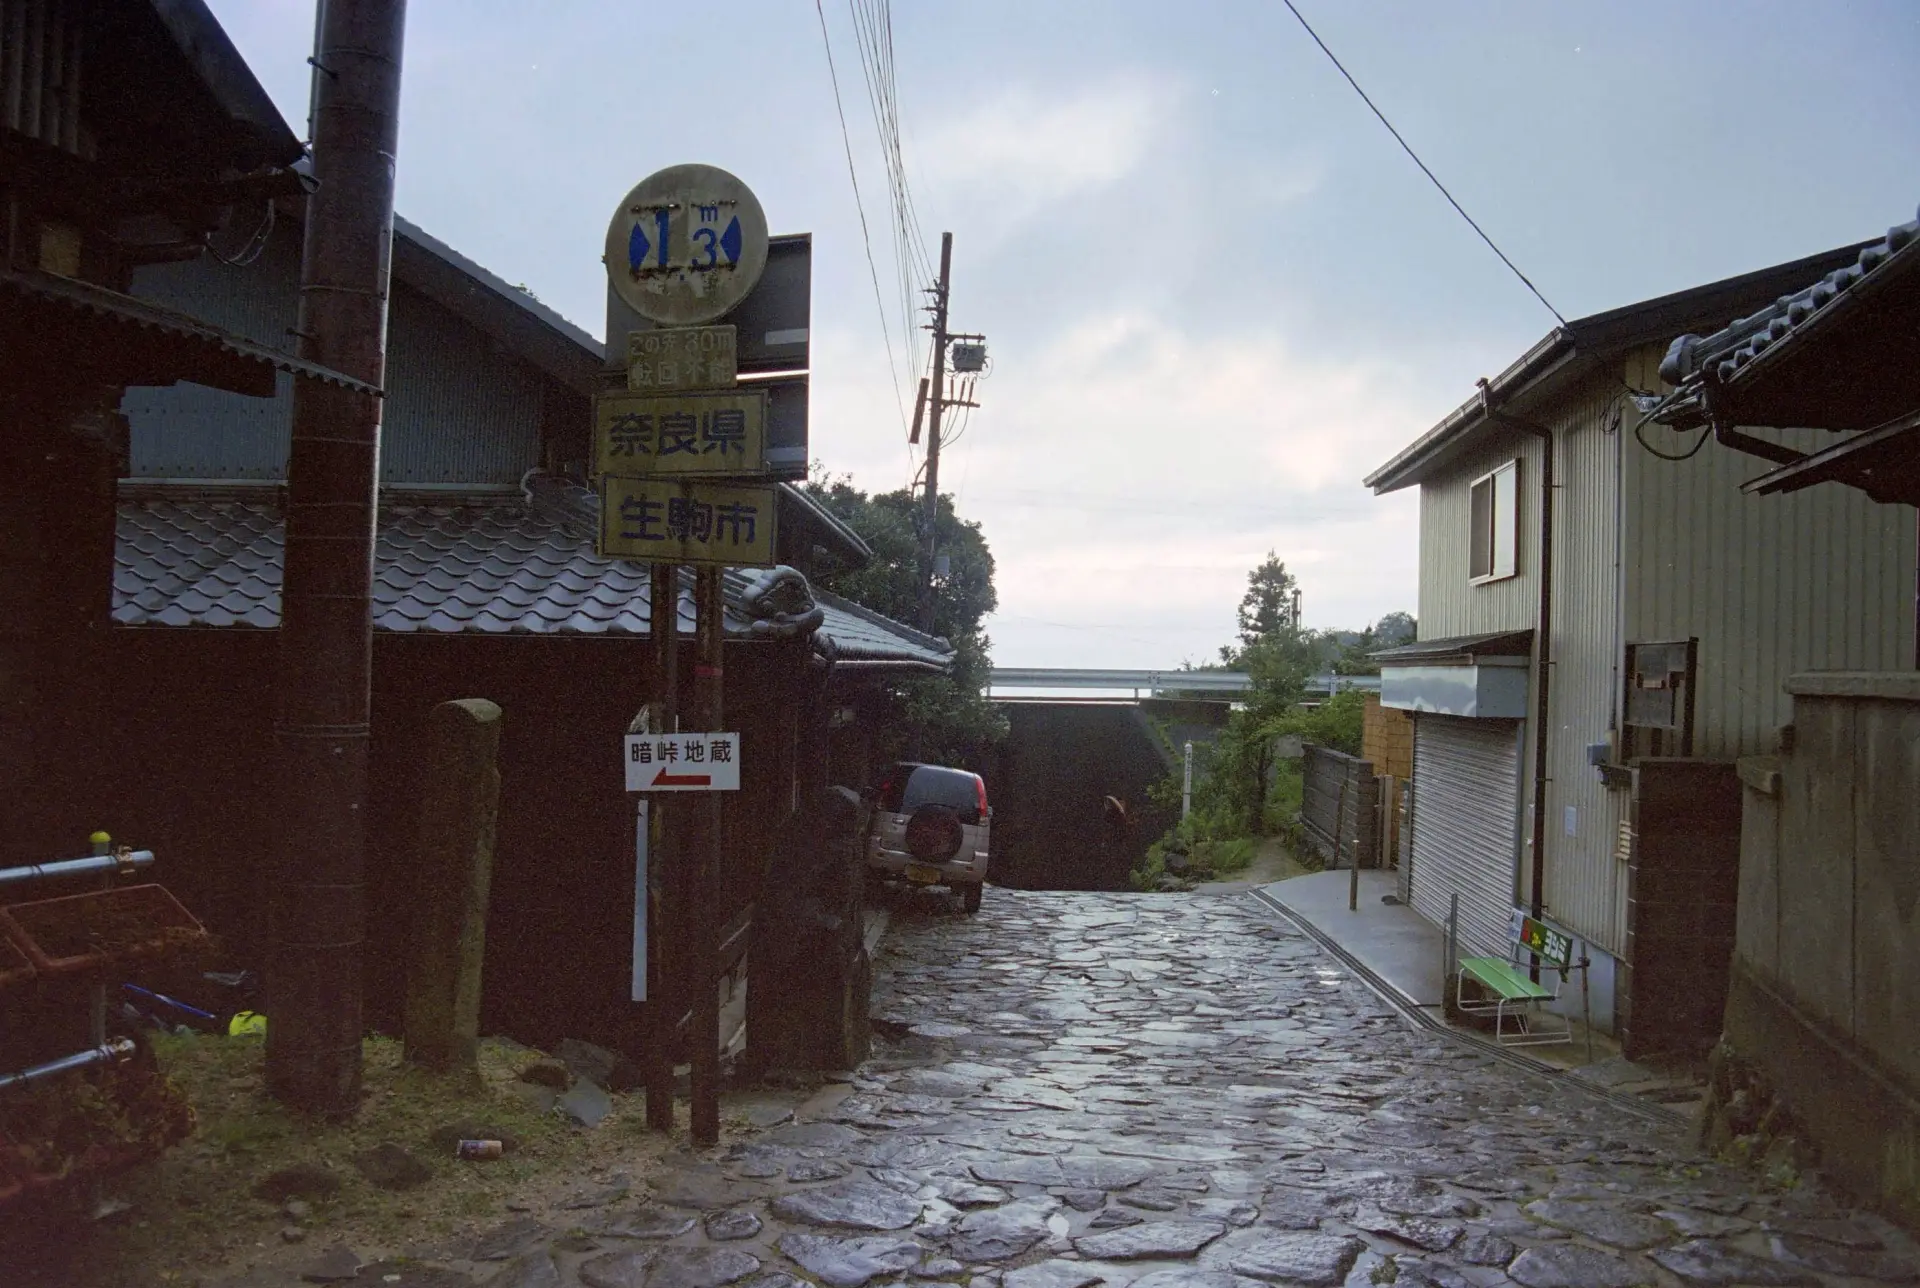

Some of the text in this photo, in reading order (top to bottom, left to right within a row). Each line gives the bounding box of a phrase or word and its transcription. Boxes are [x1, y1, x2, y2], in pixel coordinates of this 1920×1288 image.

[699, 206, 718, 222] m
[609, 409, 747, 456] 奈良県
[619, 494, 757, 545] 生駒市
[631, 740, 732, 764] 暗峠地蔵
